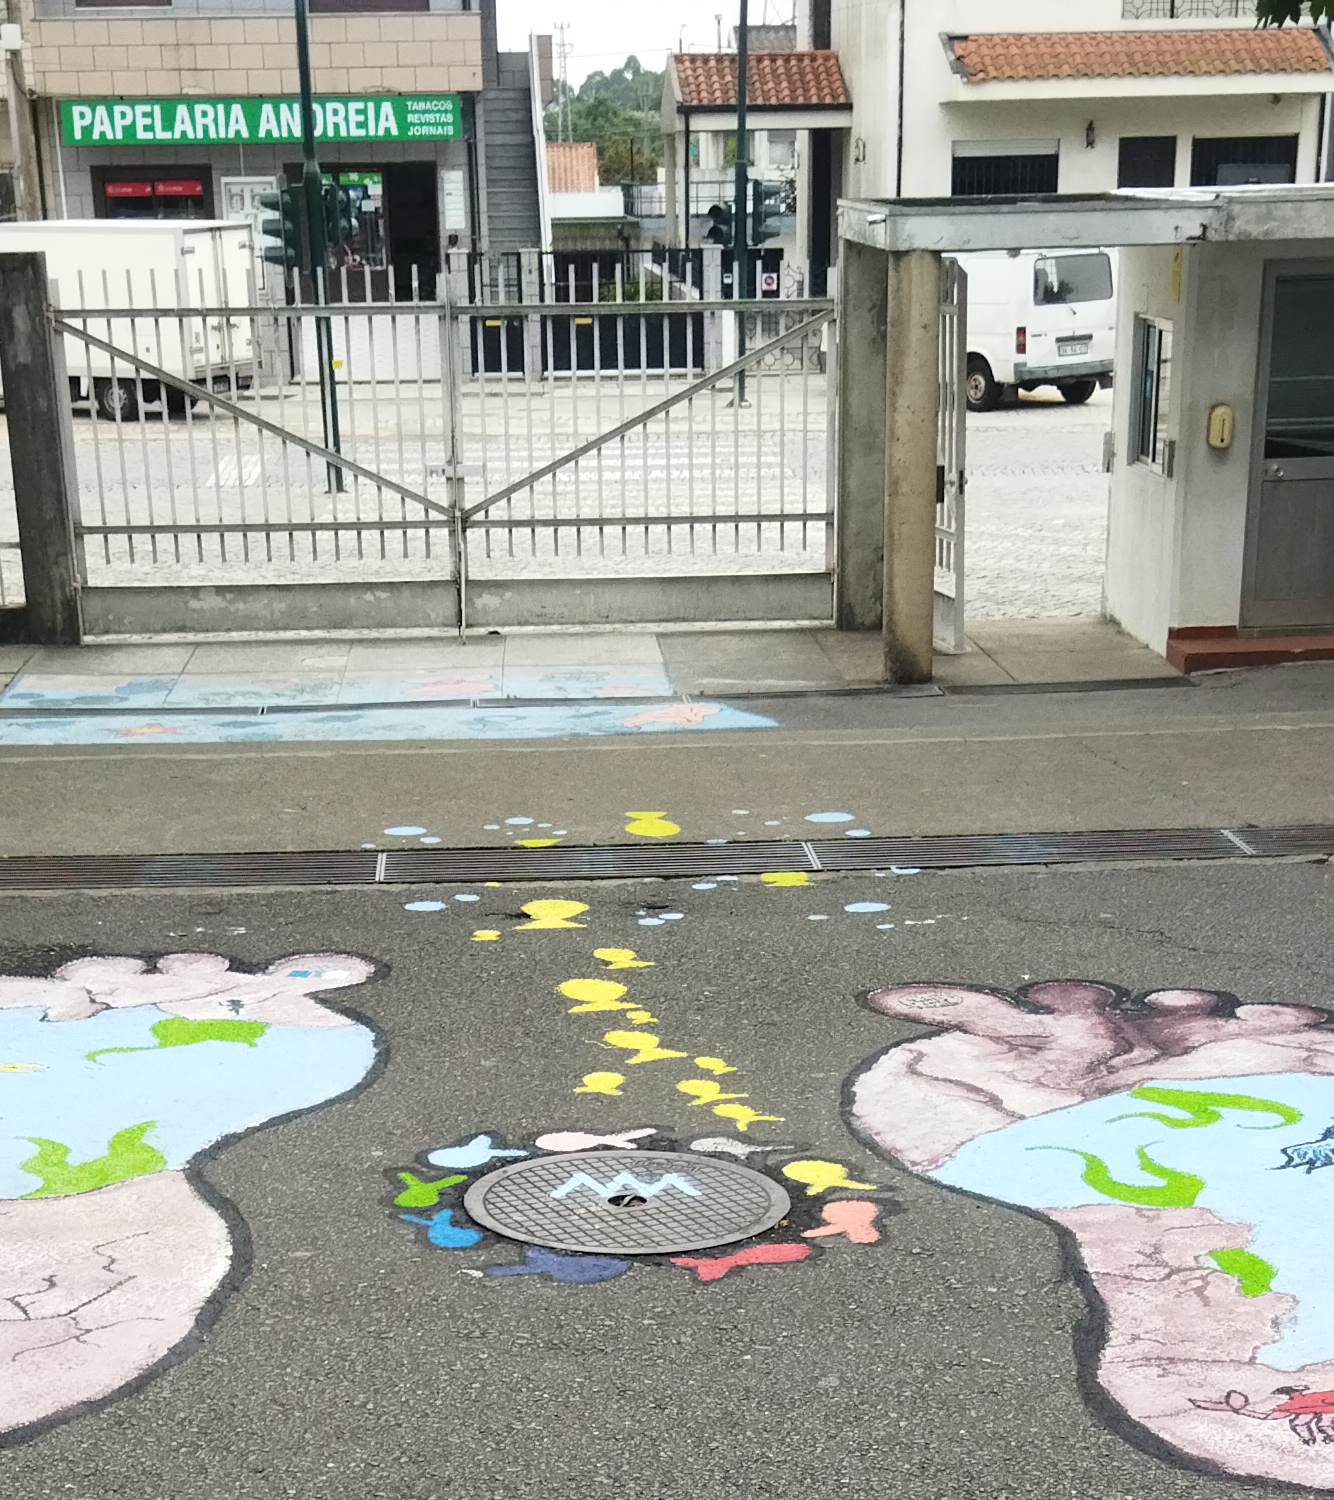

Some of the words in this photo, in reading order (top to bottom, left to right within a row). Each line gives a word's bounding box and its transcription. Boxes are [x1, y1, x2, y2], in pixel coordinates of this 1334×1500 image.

[406, 99, 454, 112] TABACOS
[71, 103, 249, 140] PAPELARIA
[258, 101, 399, 138] ANDREIA
[406, 112, 455, 125] REVISTAS
[407, 125, 455, 137] JORNAIS
